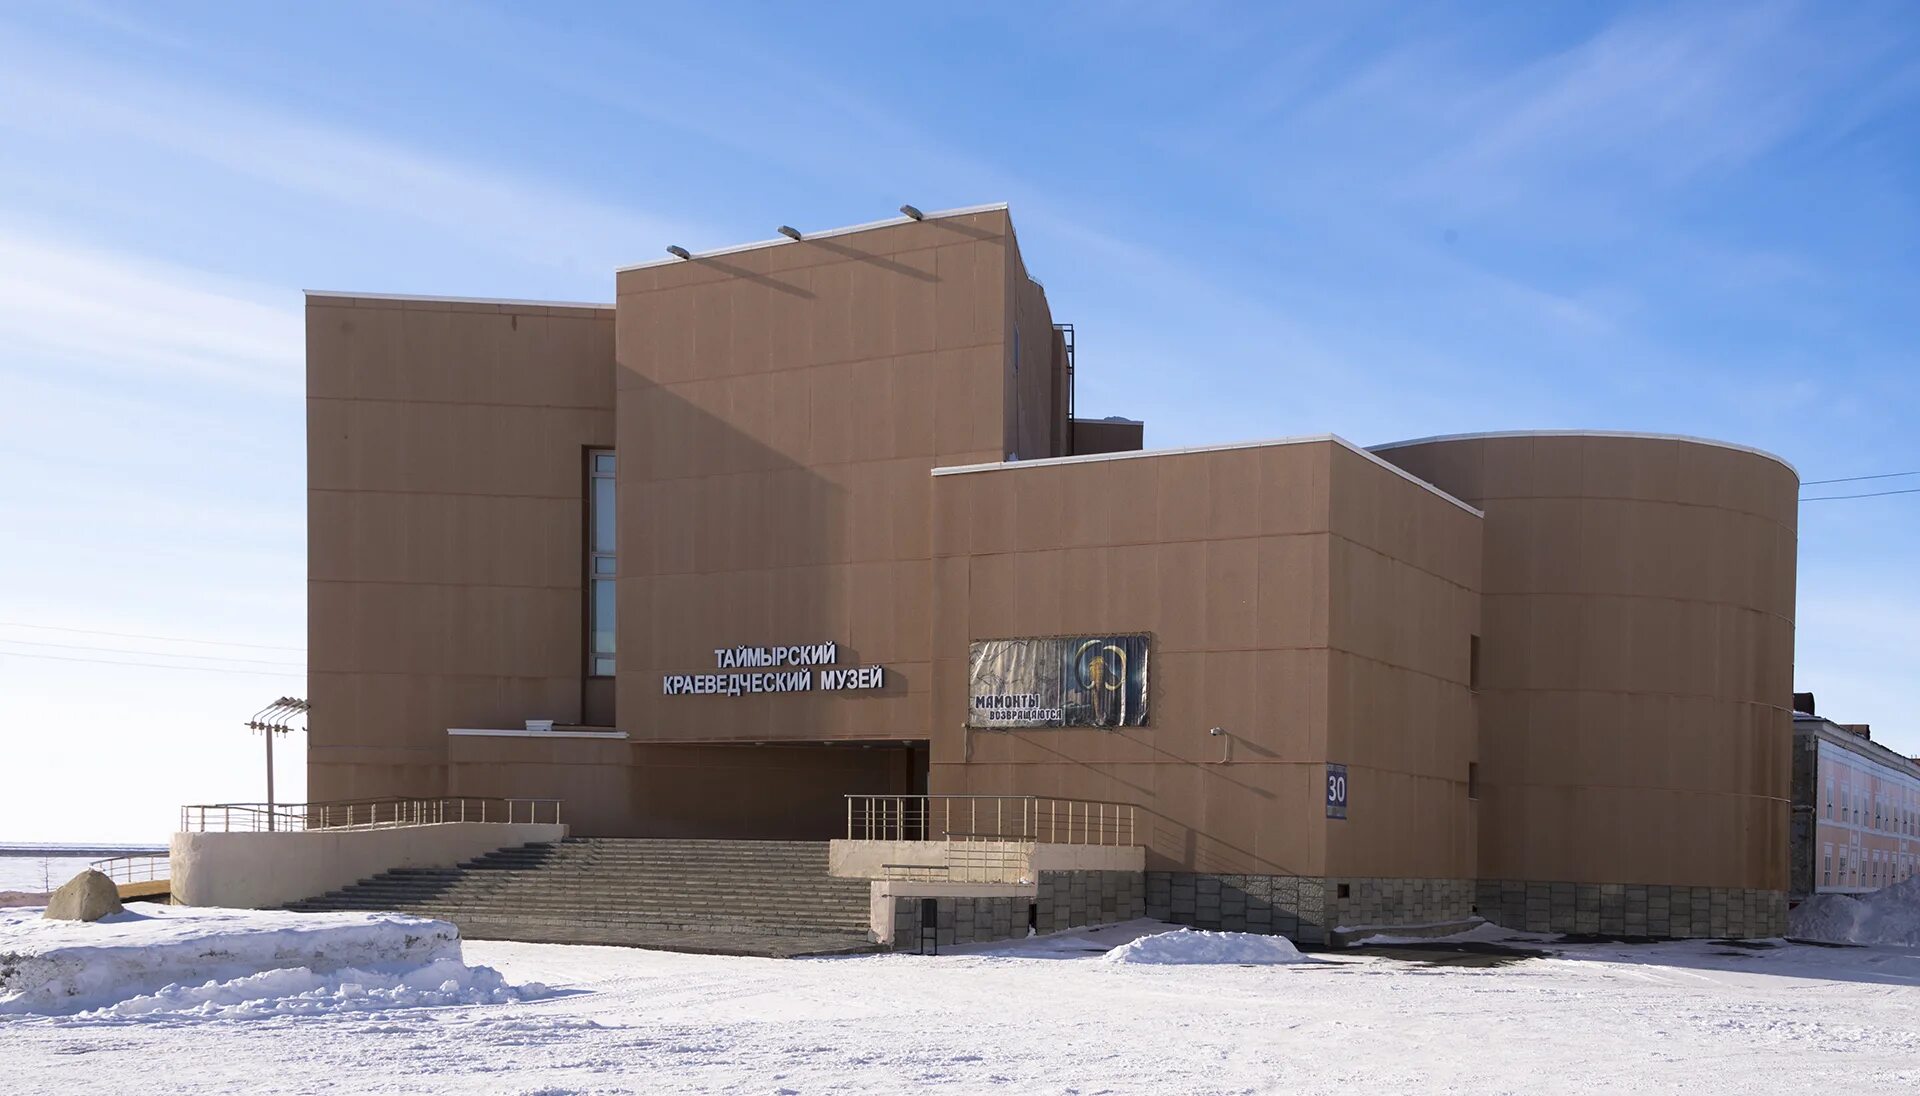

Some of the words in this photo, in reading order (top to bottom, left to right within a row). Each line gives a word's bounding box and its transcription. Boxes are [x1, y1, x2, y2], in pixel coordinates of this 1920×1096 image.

[714, 641, 836, 668] ТАЙМЫРСКИЙ
[663, 668, 811, 697] КРАЕВЕДЧЕСКИЙ
[820, 665, 883, 690] МУЗЕЙ
[975, 693, 1040, 709] МАМОНТЫ
[989, 709, 1062, 722] ВОЗВРАЩАЮТСЯ
[1328, 775, 1345, 802] 30
